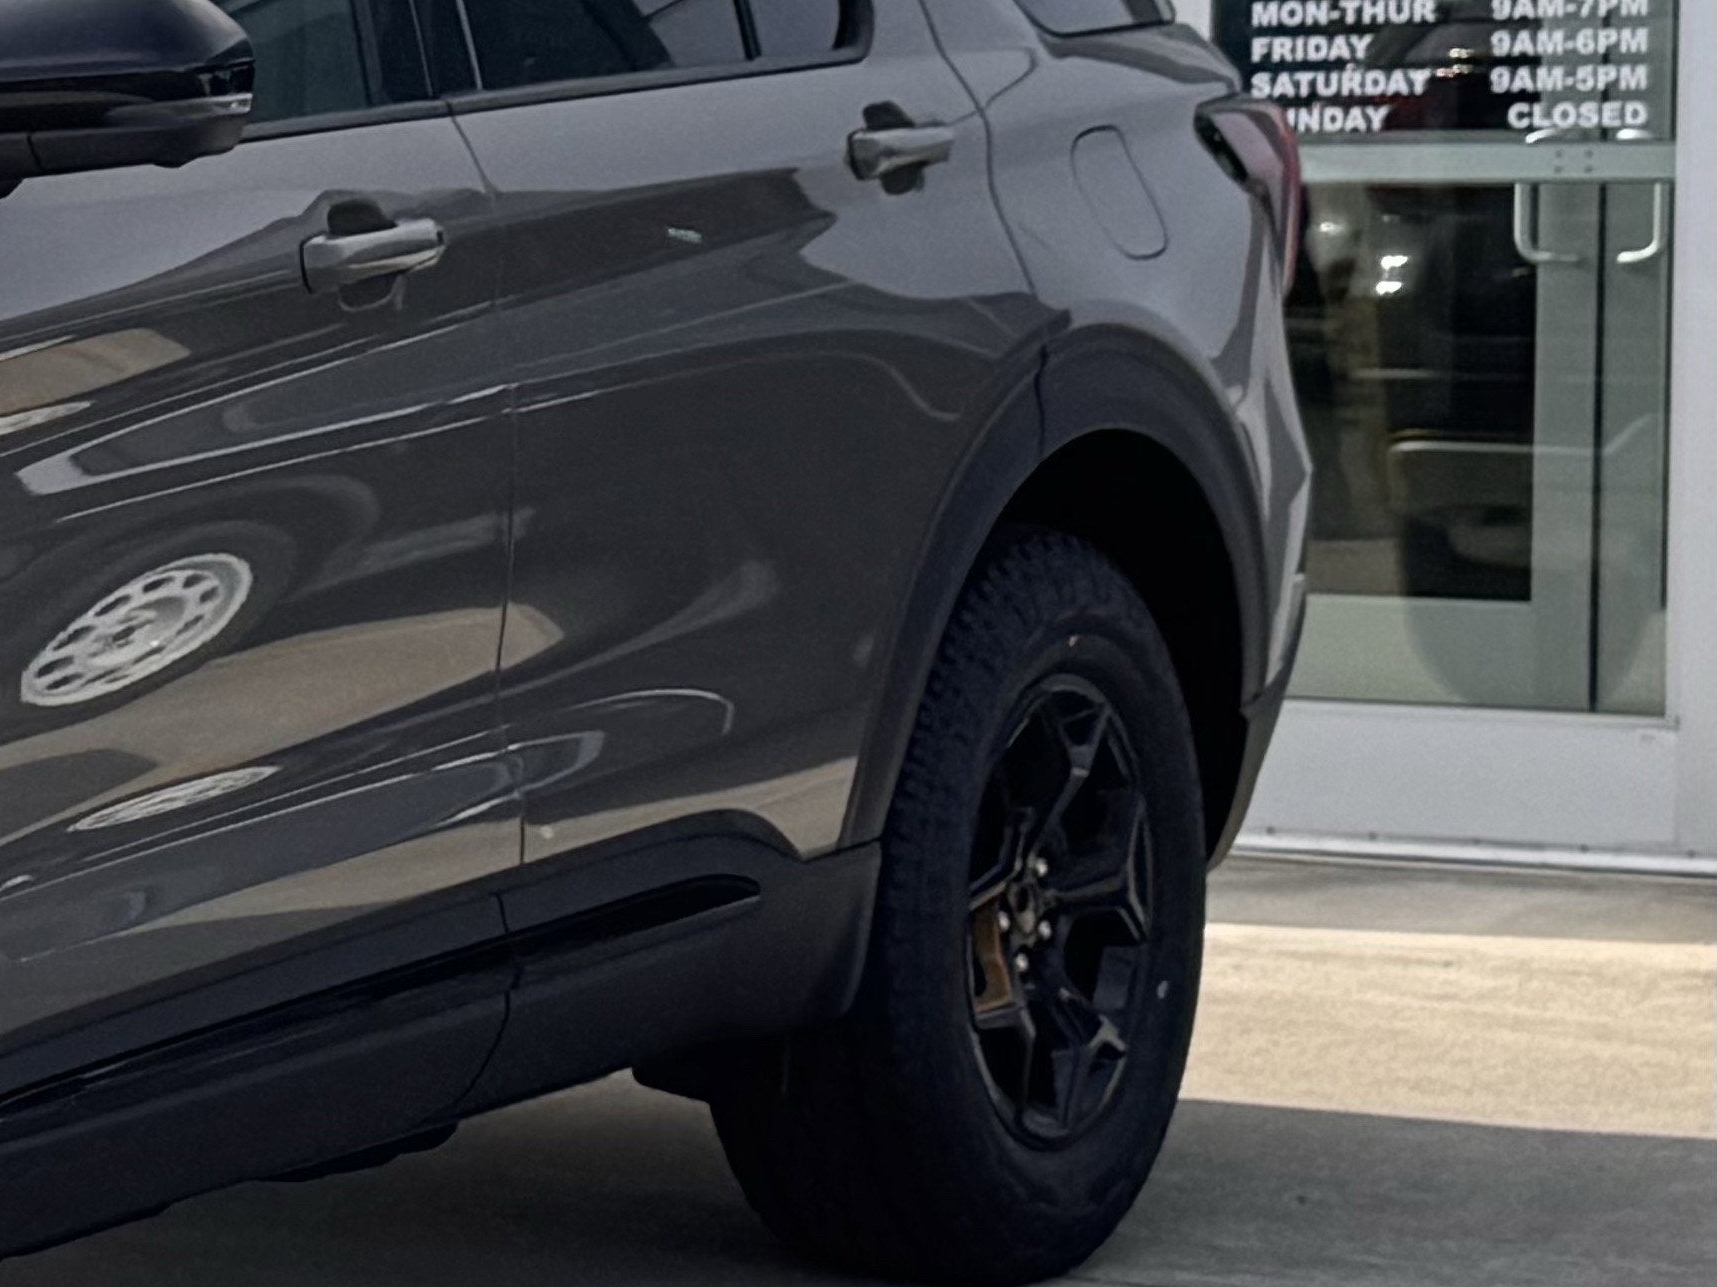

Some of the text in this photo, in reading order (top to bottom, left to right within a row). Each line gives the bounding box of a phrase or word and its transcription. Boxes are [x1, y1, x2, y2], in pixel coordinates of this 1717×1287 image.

[1251, 28, 1648, 63] FRIDAY 9AM-6PM
[1251, 64, 1648, 99] SATURDAY 9AM-5PM
[1286, 101, 1648, 133] NDAY CLOSED
